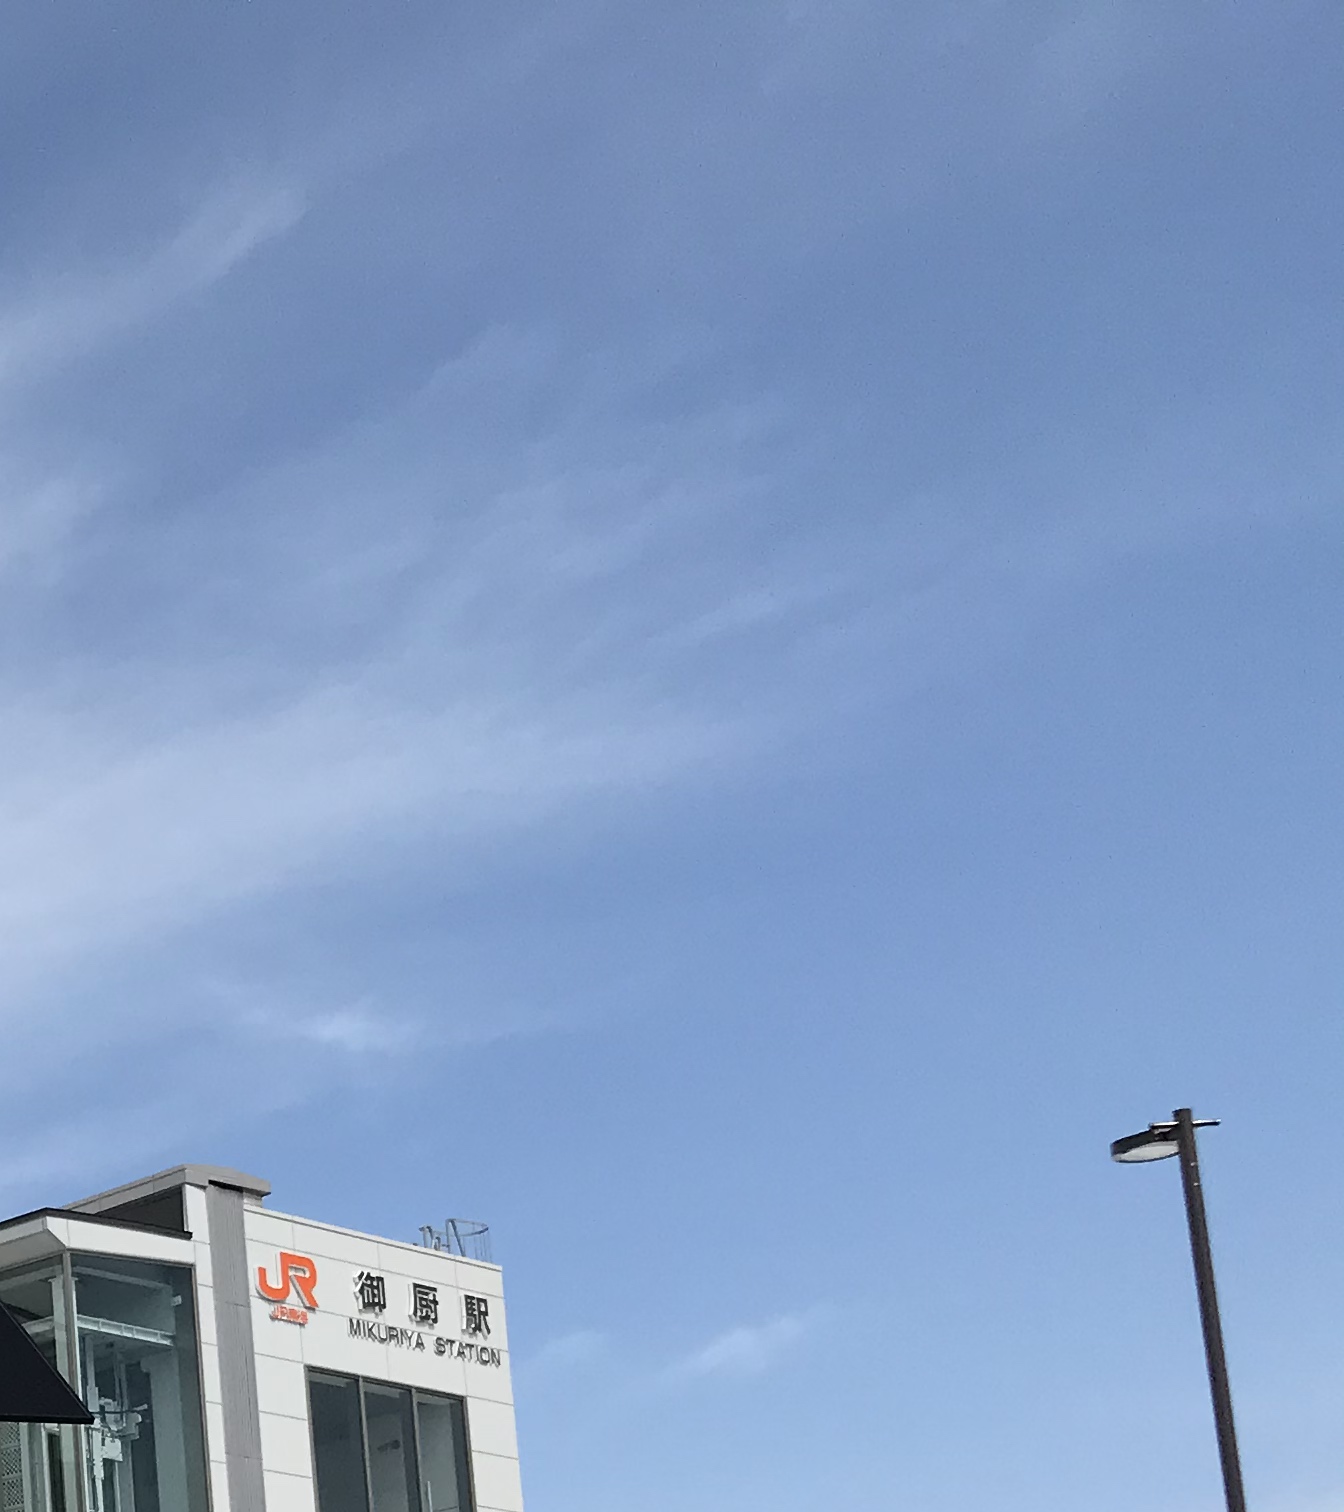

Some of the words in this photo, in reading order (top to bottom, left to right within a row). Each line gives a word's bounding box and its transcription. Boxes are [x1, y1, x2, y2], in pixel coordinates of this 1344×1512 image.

[257, 1251, 319, 1309] JR
[356, 1270, 491, 1335] 御厨駅
[348, 1317, 426, 1352] MIKURIYA
[434, 1336, 501, 1367] STATION
